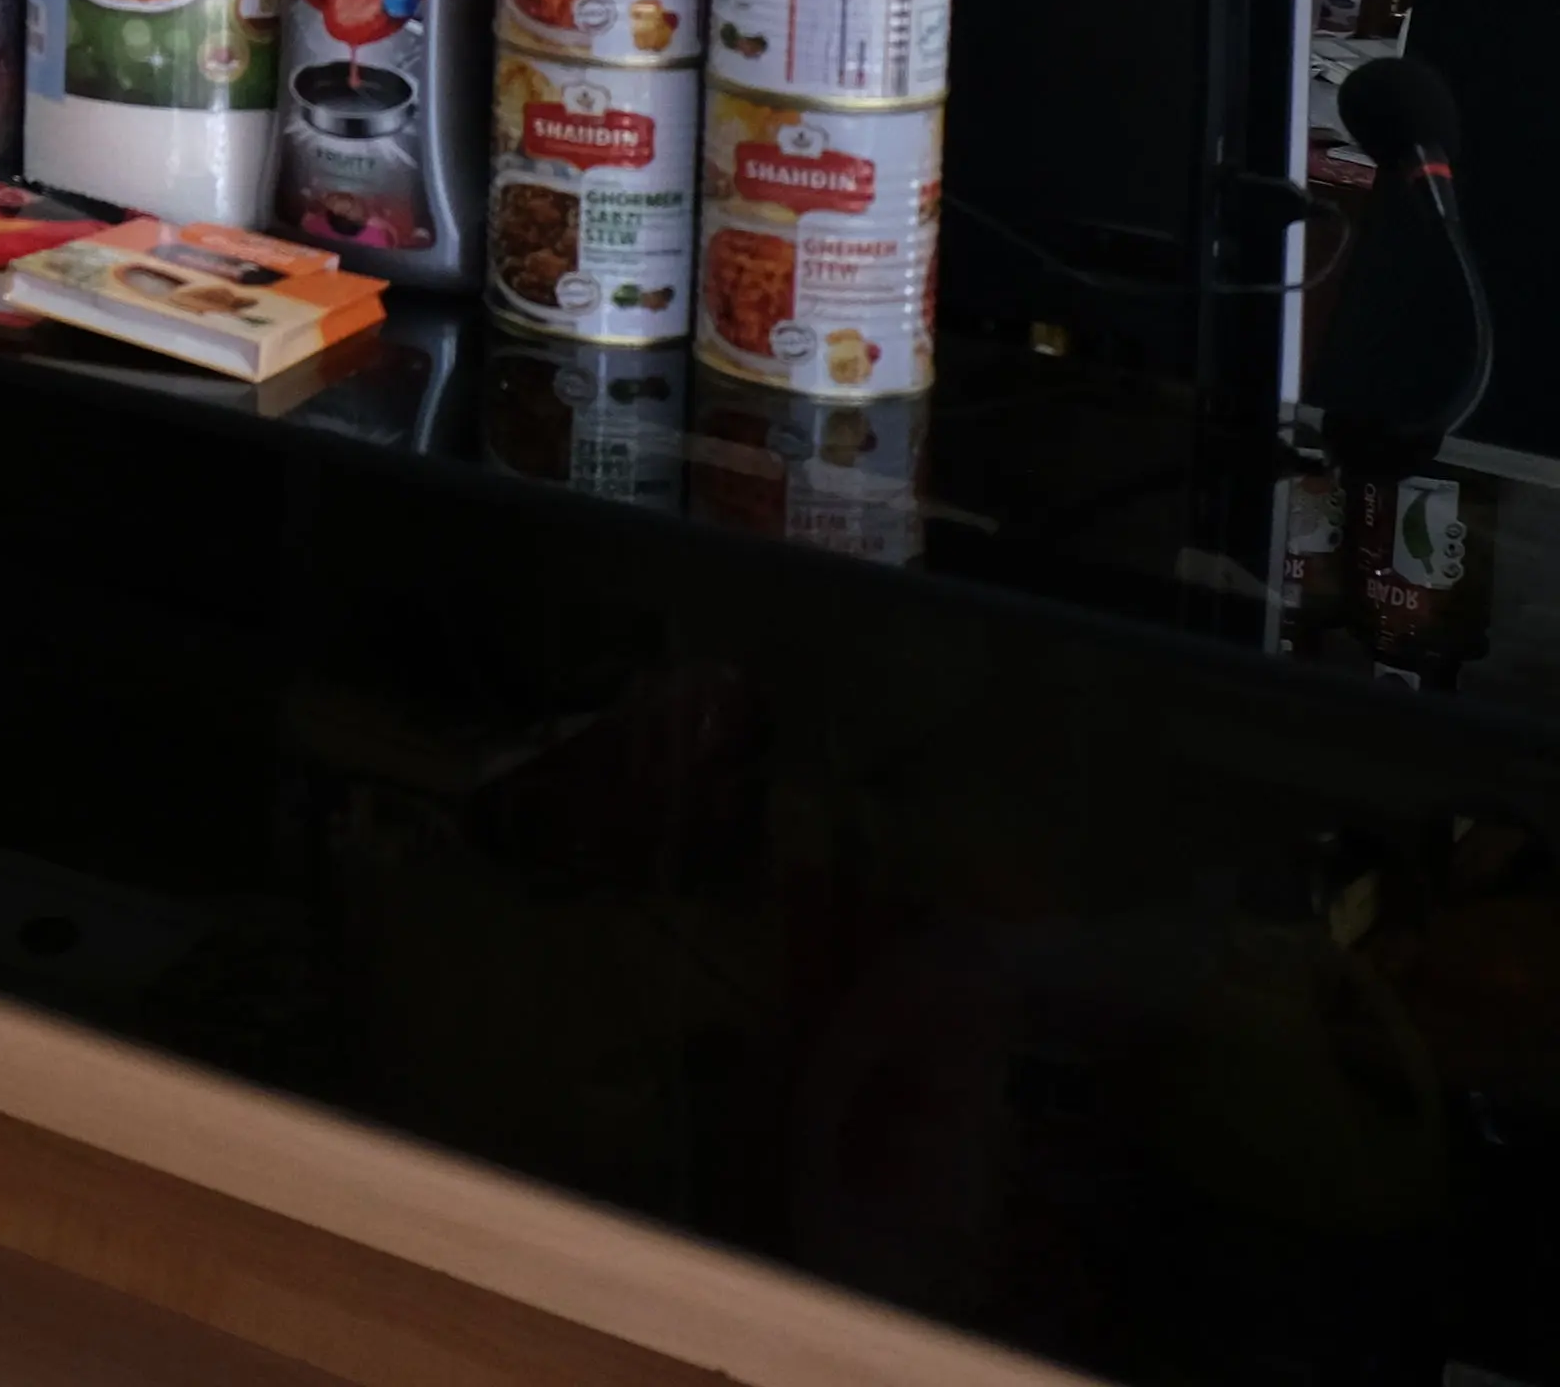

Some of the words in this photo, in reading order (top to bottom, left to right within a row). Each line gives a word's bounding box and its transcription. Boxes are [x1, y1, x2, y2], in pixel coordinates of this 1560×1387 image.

[533, 117, 639, 148] SHAHDIN
[745, 160, 859, 192] SHAHDIN
[585, 209, 644, 227] SABZI
[585, 227, 637, 245] STEW
